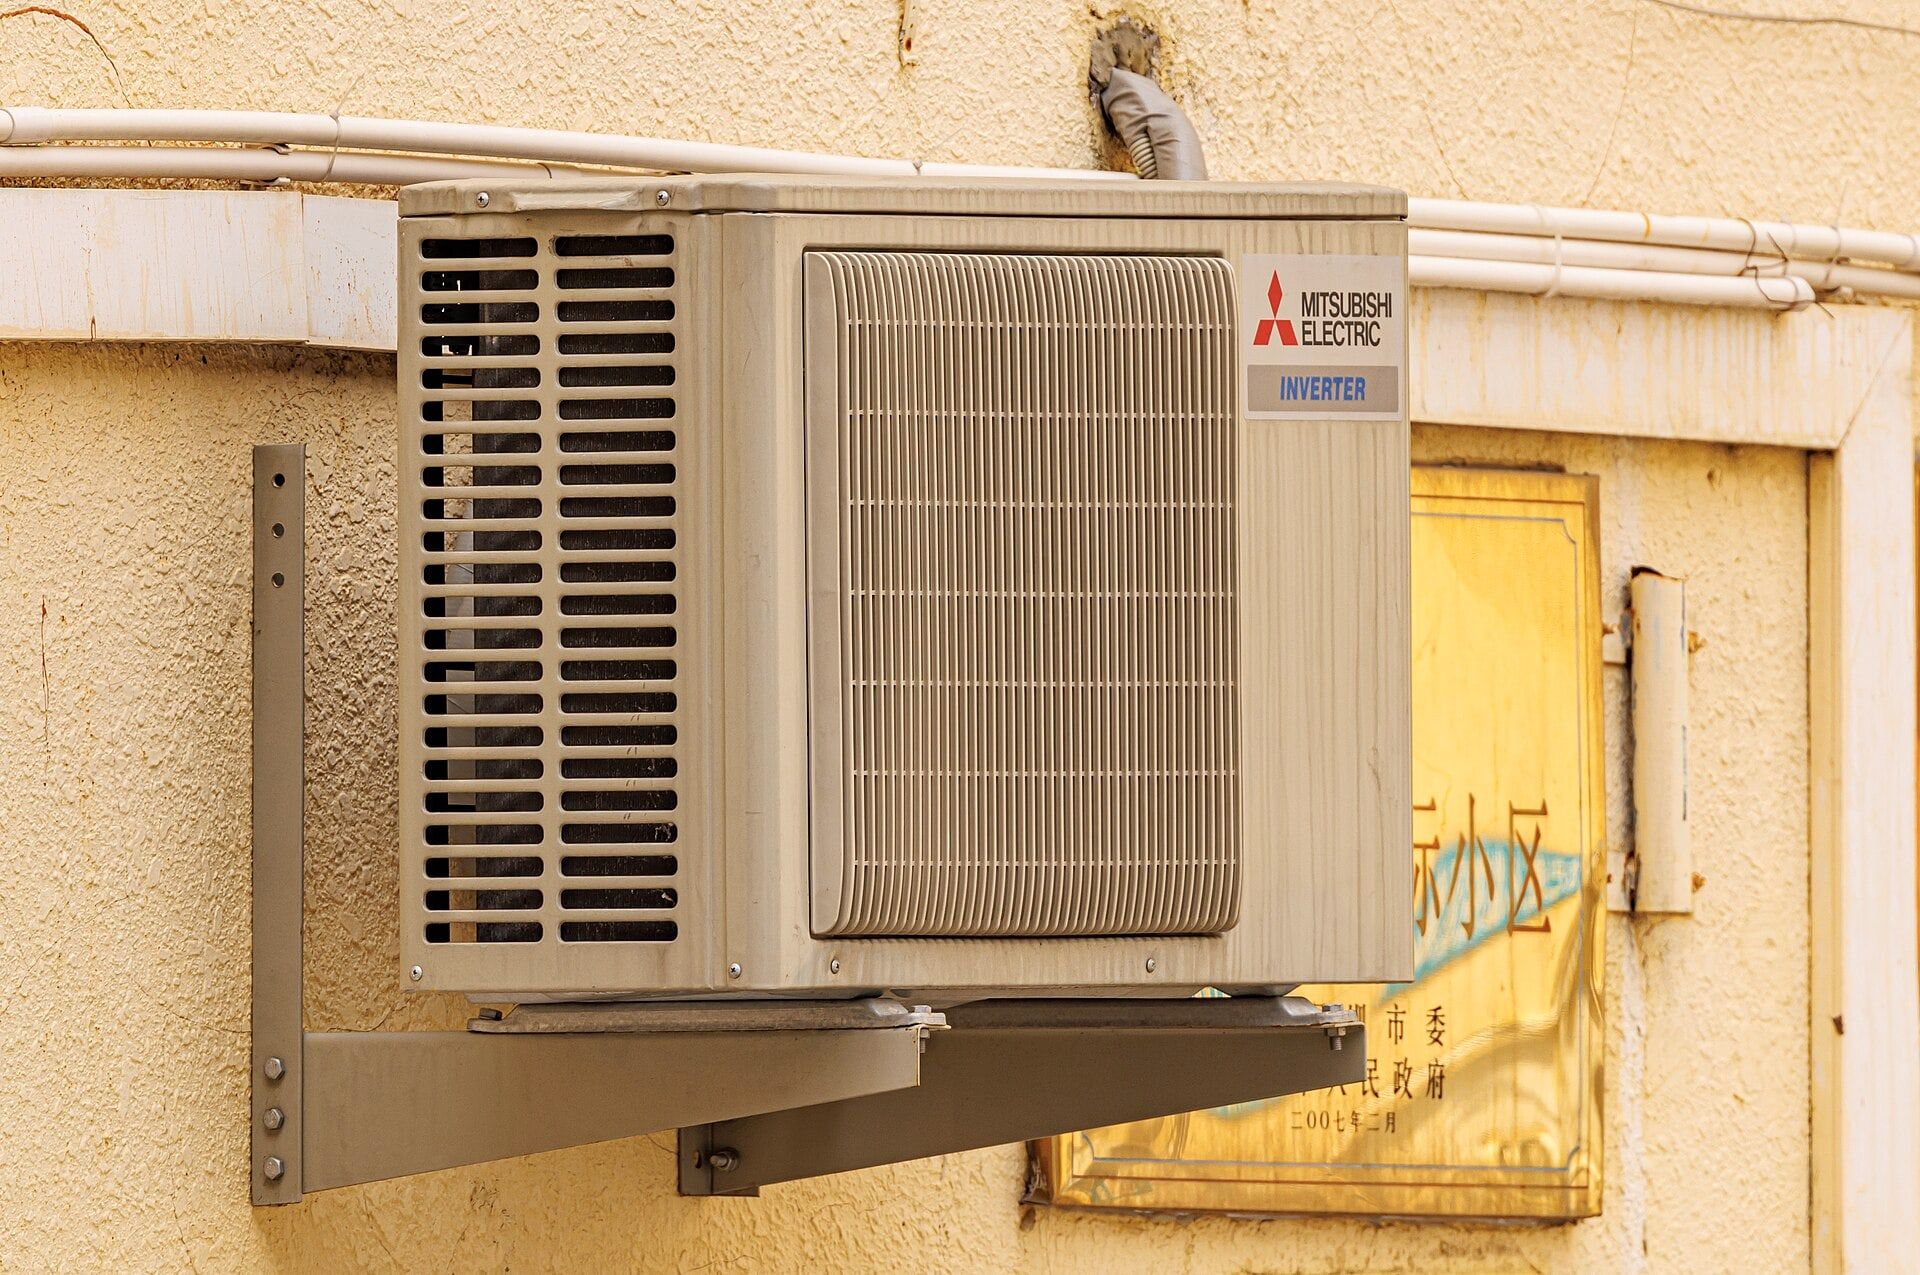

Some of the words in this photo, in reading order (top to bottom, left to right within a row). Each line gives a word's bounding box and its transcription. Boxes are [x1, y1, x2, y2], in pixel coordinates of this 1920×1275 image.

[1301, 291, 1392, 318] MITSUBISHI
[1301, 320, 1381, 346] ELECTRIC
[1280, 375, 1366, 401] INVERTER
[1349, 1003, 1445, 1046] 市委
